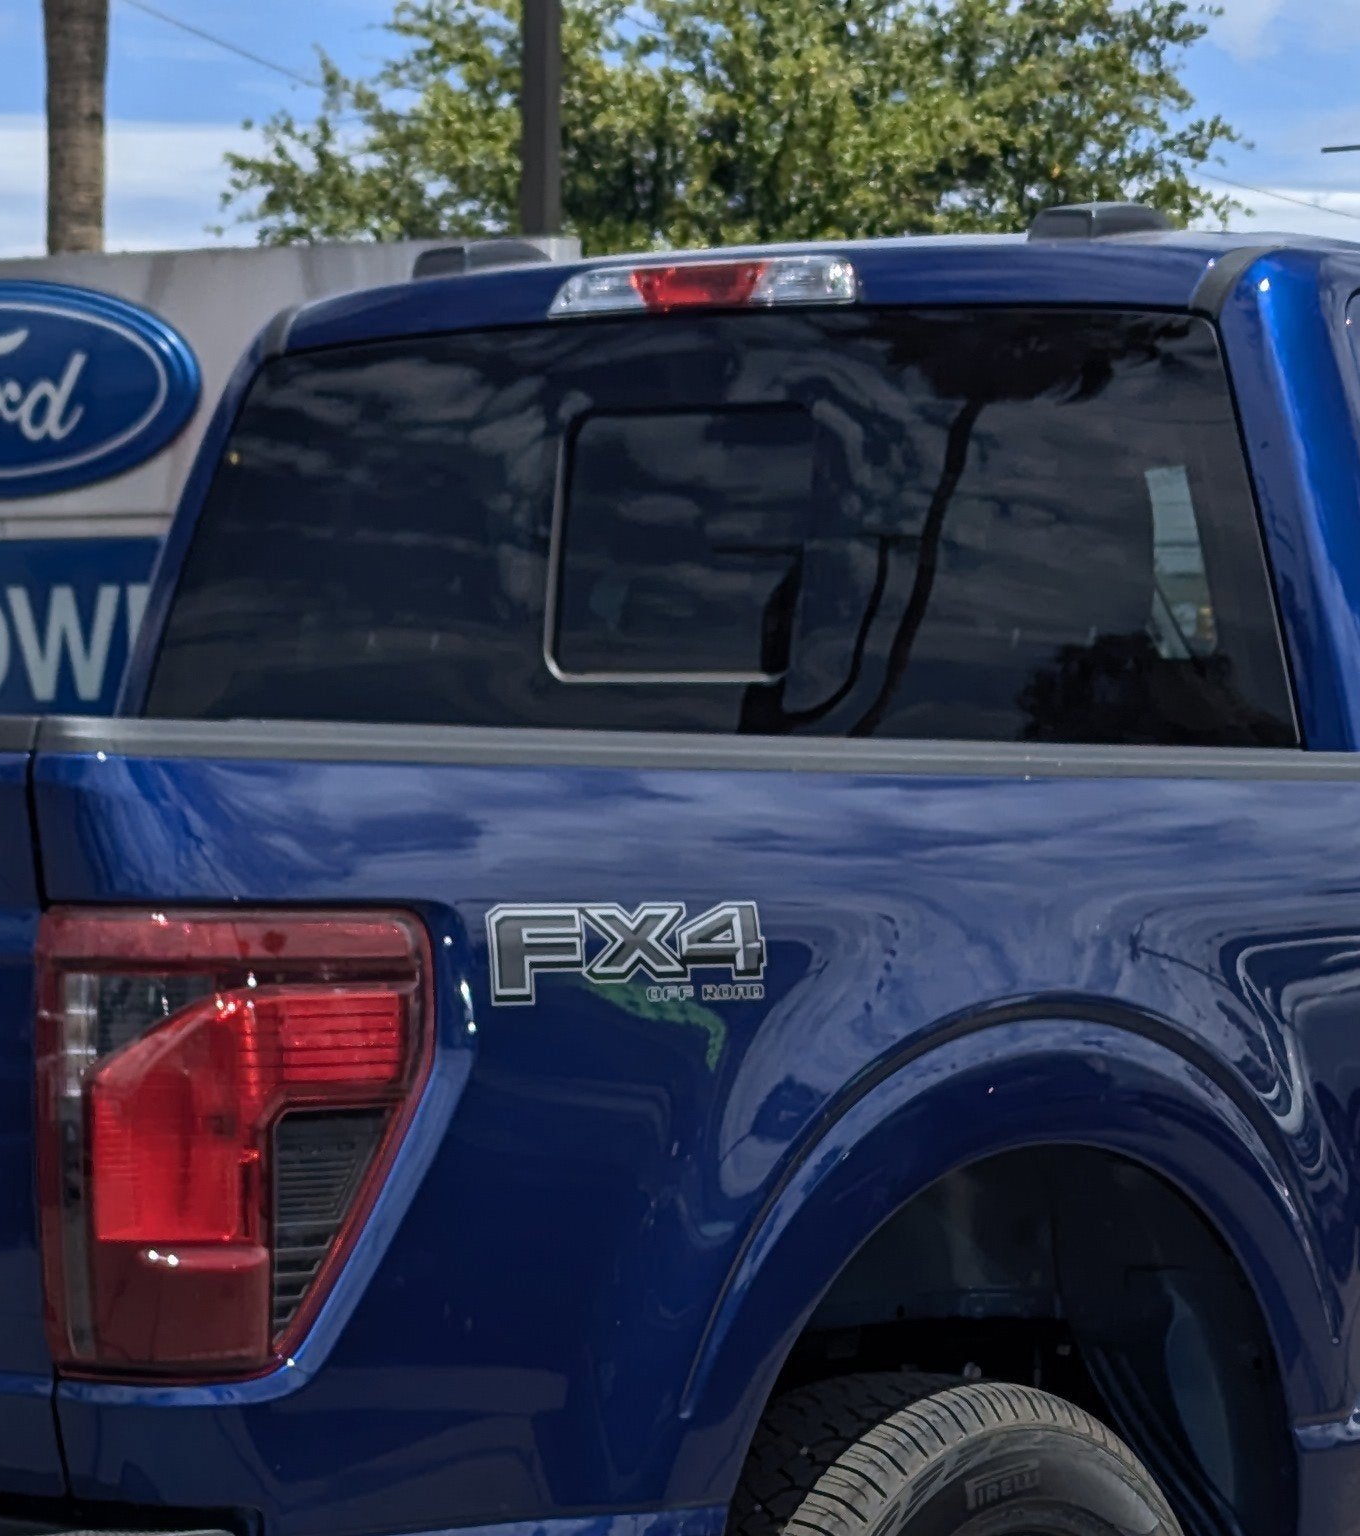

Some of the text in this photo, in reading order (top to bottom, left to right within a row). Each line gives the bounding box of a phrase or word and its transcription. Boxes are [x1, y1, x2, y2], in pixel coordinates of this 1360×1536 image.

[485, 901, 767, 1006] FX4
[646, 983, 766, 1003] OFF ROAD
